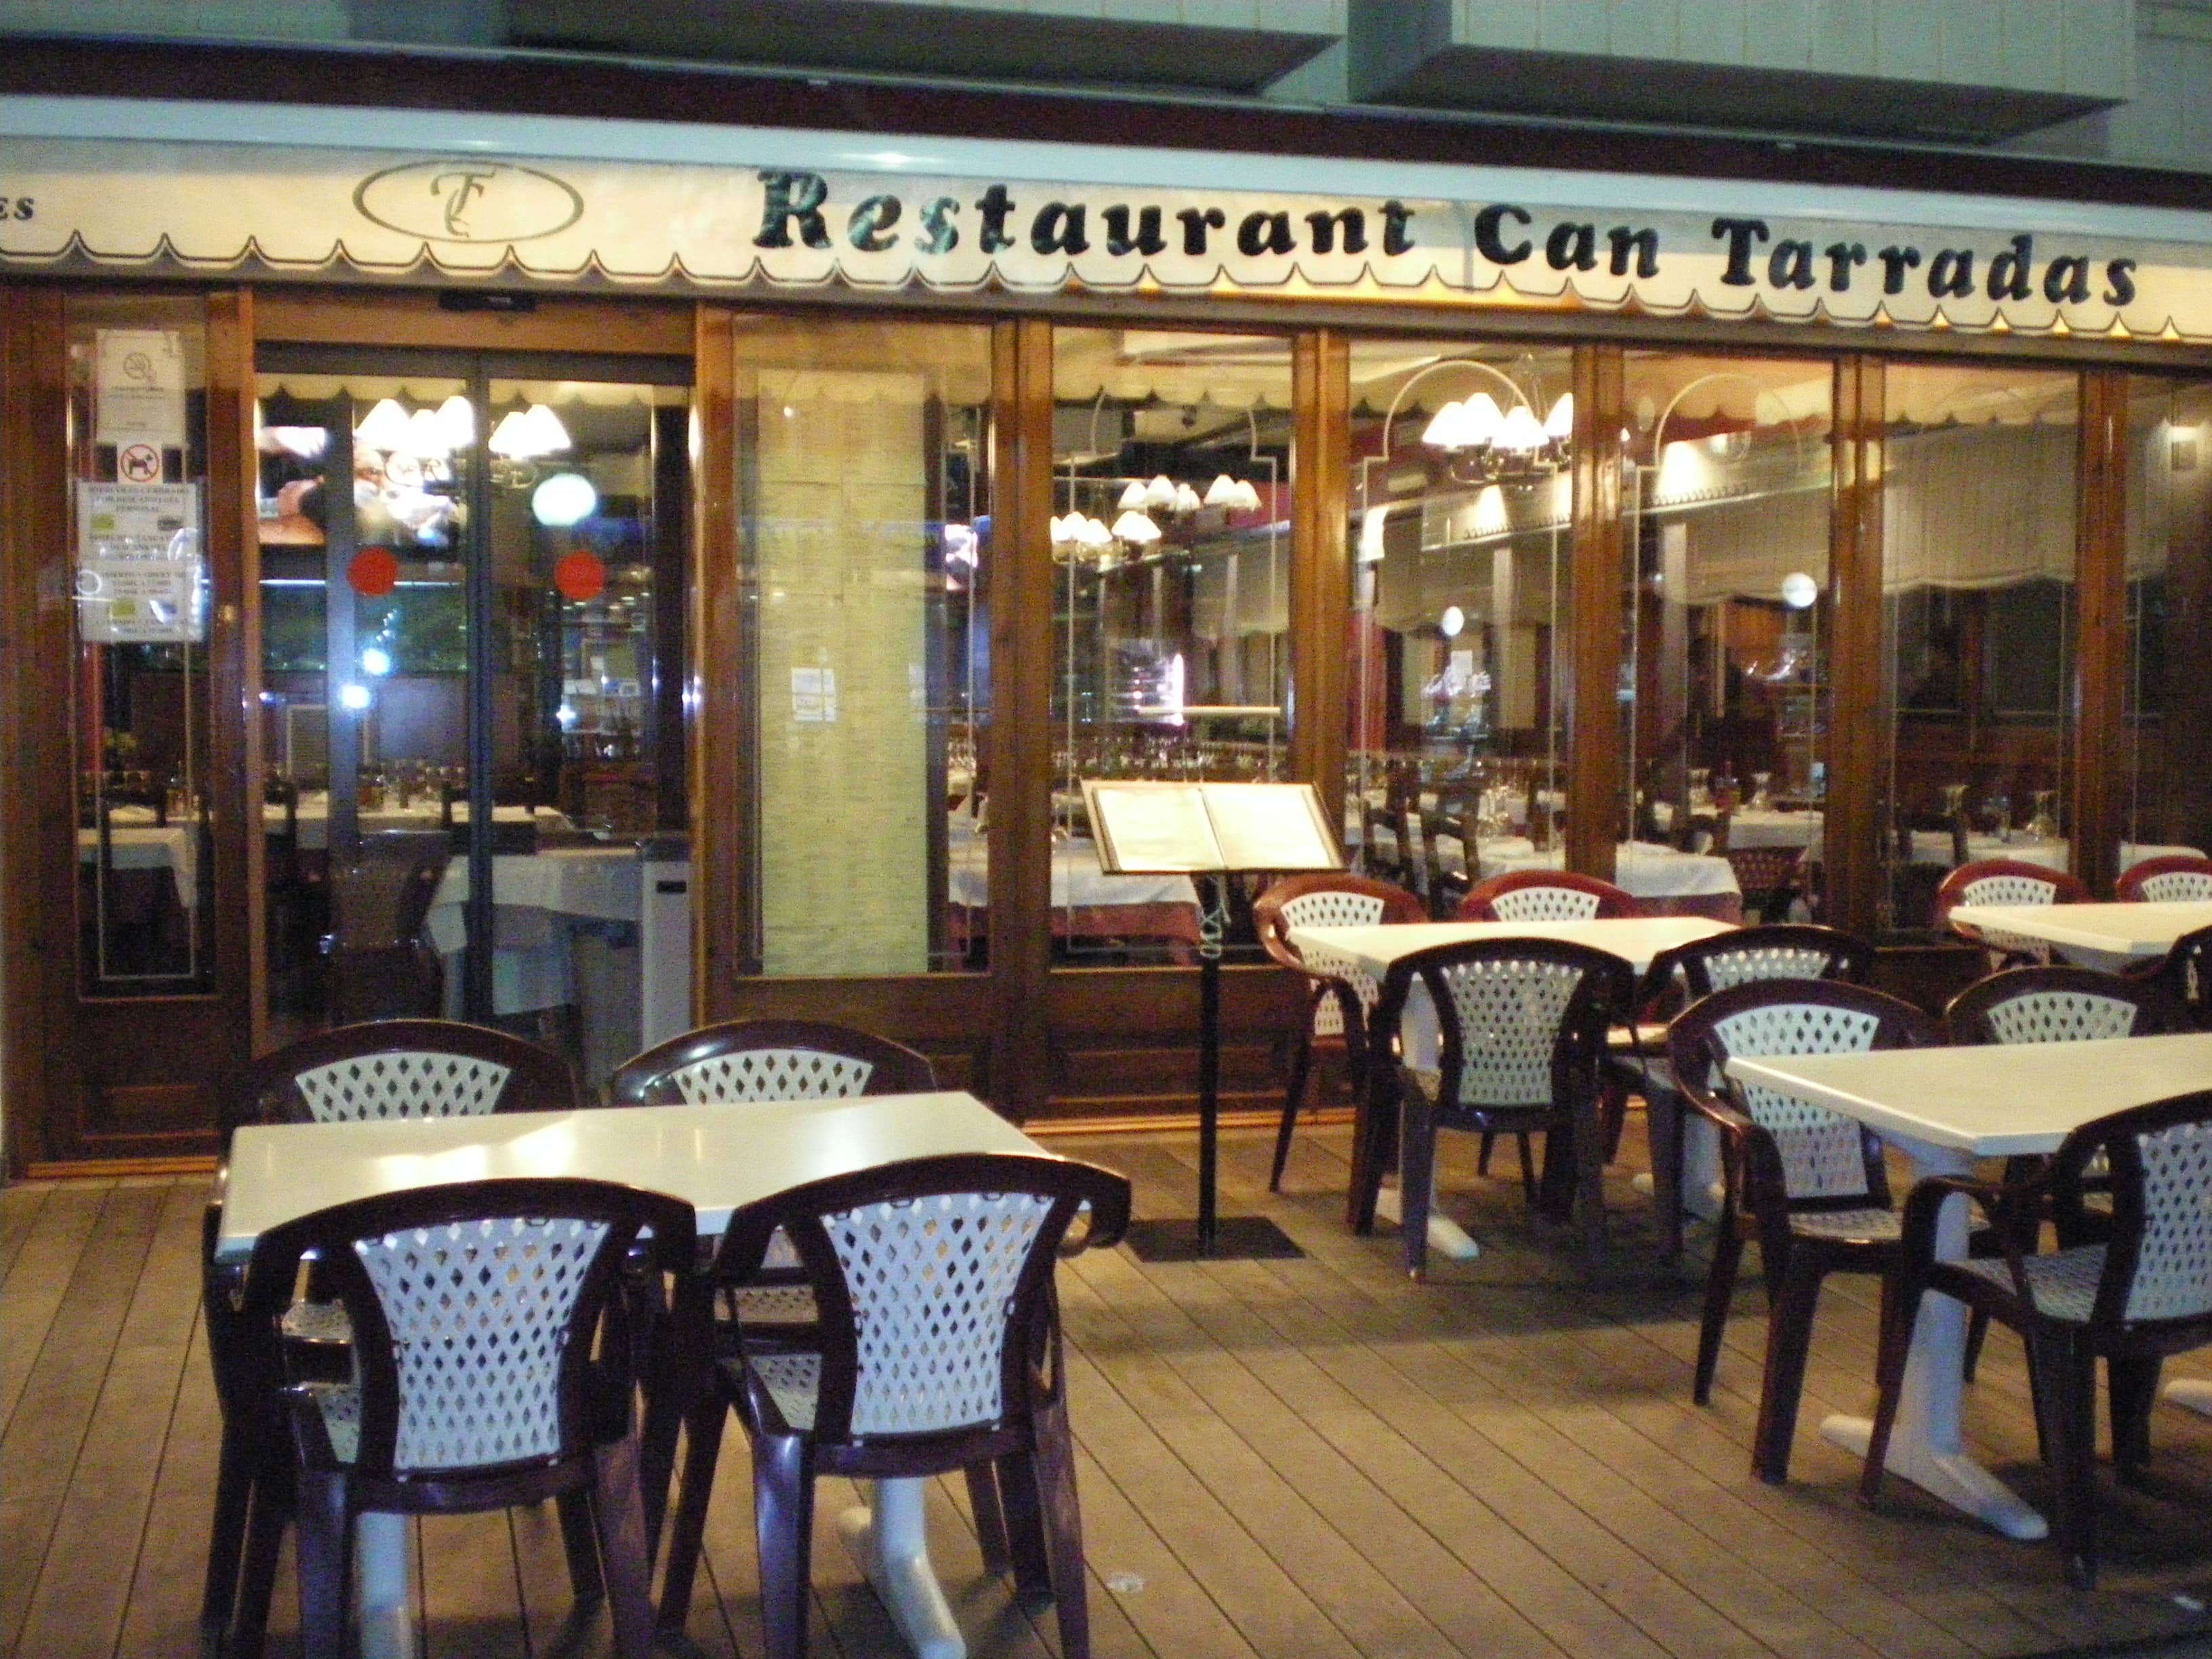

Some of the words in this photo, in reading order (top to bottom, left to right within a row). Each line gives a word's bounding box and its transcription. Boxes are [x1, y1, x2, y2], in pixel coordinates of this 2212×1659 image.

[752, 169, 1416, 258] Restaurant
[1473, 203, 1660, 279] Can
[1711, 216, 2137, 308] Tarradas
